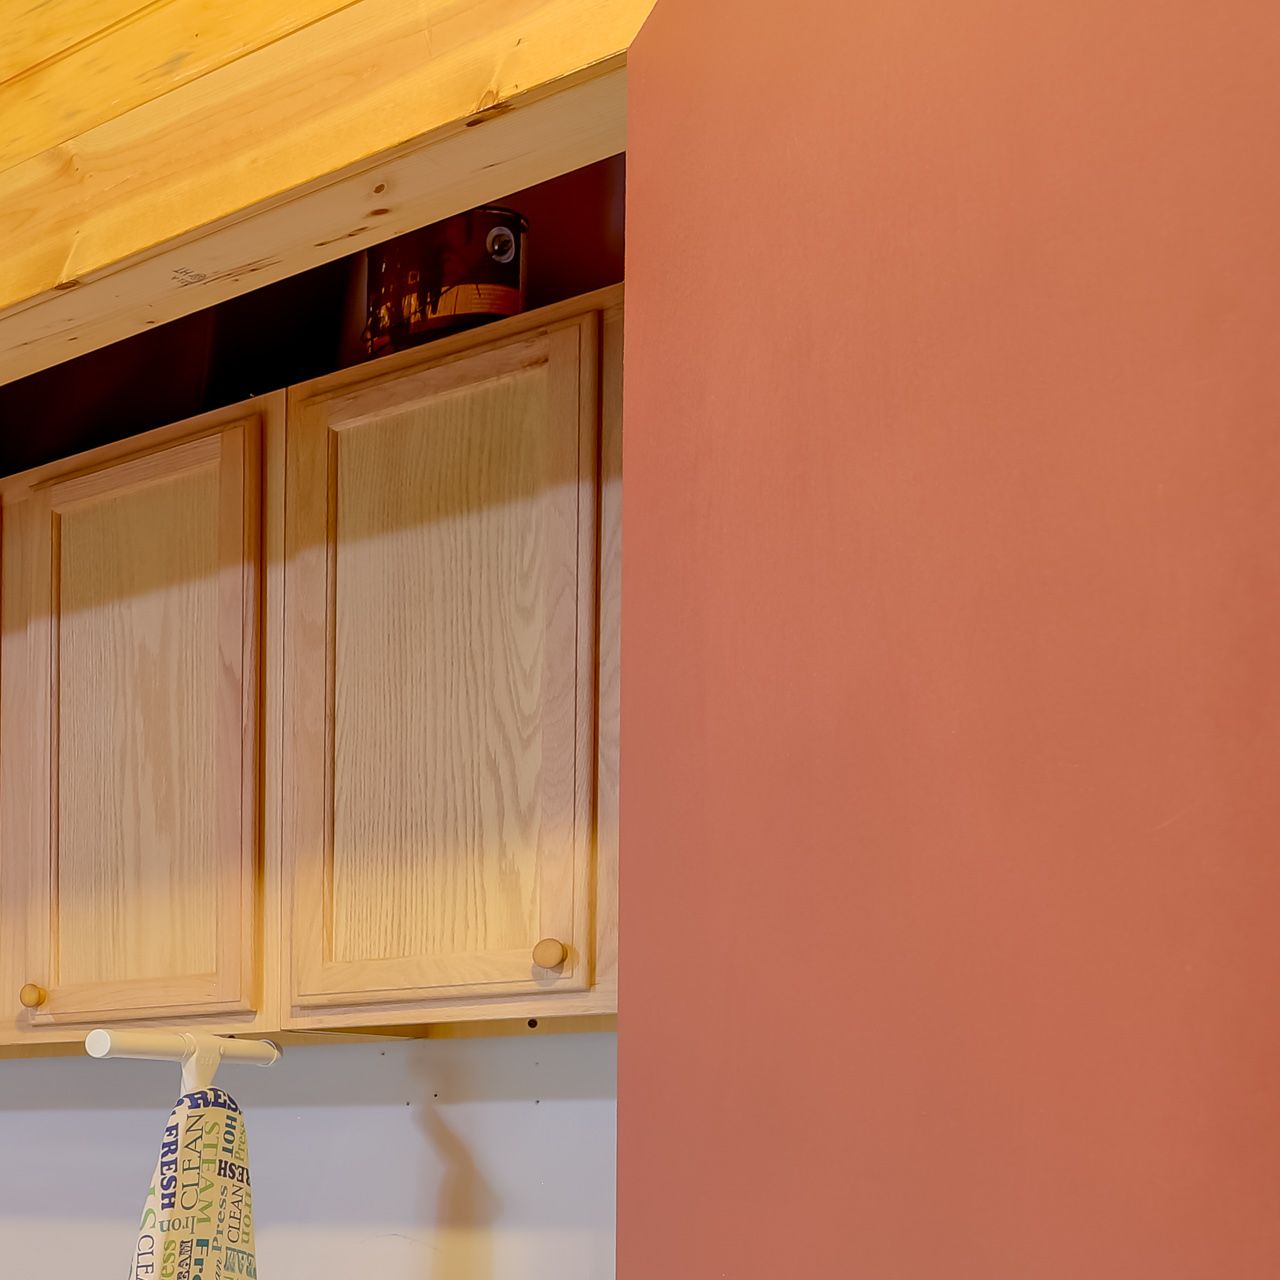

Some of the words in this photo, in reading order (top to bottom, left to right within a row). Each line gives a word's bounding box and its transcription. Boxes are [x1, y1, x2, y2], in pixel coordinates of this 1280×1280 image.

[160, 1122, 179, 1210] FRESH
[181, 1113, 206, 1210] CLEAN
[222, 1114, 237, 1158] HOT
[197, 1120, 220, 1224] STEAM
[217, 1159, 251, 1187] RESH
[159, 1215, 196, 1234] Iron
[212, 1185, 228, 1252] Press
[227, 1183, 244, 1243] CLEAN
